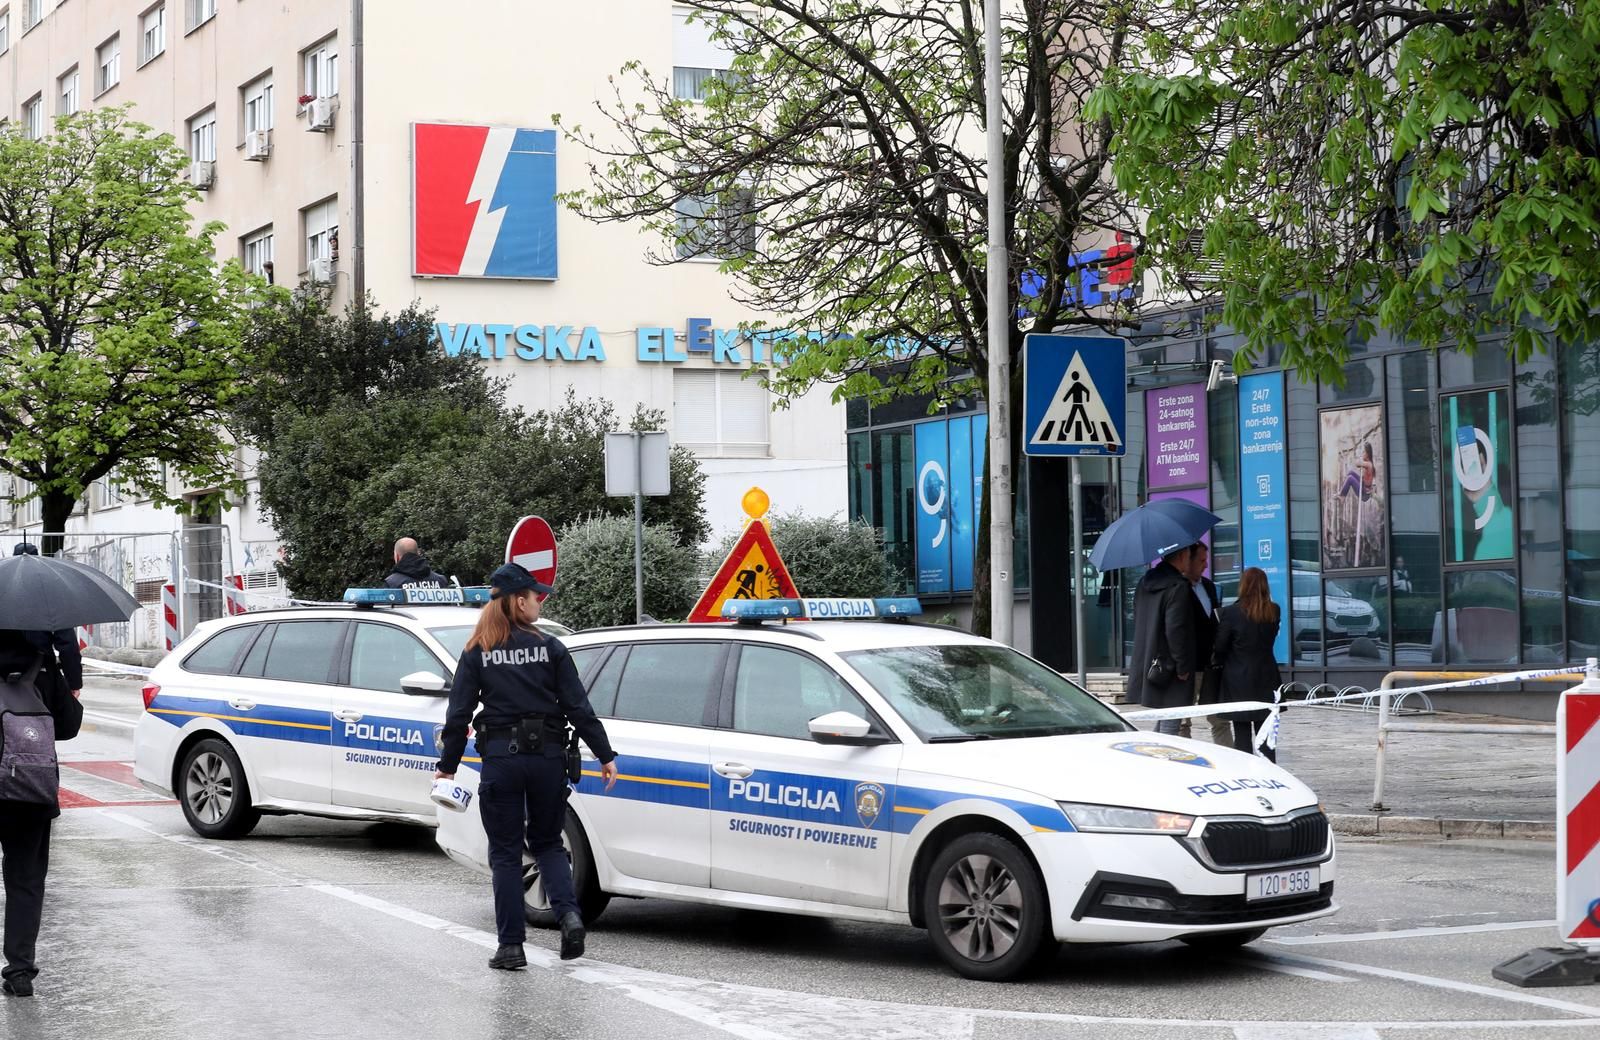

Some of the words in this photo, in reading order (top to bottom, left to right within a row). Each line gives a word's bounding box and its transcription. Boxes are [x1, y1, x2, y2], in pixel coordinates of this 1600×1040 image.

[390, 321, 606, 361] VATSKA
[1158, 396, 1176, 407] Erste
[1177, 395, 1194, 404] zona
[1252, 388, 1270, 401] 24/7
[1159, 408, 1194, 420] 24-satnog
[1251, 403, 1271, 414] Erste
[1157, 420, 1197, 432] bankarenja.
[1245, 415, 1278, 427] non-stop
[1253, 430, 1271, 440] zona
[1160, 441, 1178, 452] Erste
[1179, 439, 1195, 451] 24/7
[1242, 440, 1283, 453] bankarenja
[1156, 455, 1172, 464] ATM
[1173, 452, 1200, 463] banking
[1169, 466, 1187, 476] zone.
[402, 581, 441, 590] POLICIJA
[410, 590, 461, 602] POLICIJA
[809, 602, 872, 617] POLICIJA
[481, 646, 549, 667] POLICIJA
[344, 723, 424, 745] POLICIJA
[345, 752, 392, 767] SIGURNOST
[393, 758, 397, 766] I
[398, 759, 437, 772] POVJERE
[857, 785, 883, 795] POLICIJA
[1187, 779, 1290, 797] POLICIJA
[729, 780, 841, 812] POLICIJA
[729, 819, 794, 839] SIGURNOST
[796, 829, 801, 839] I
[804, 829, 878, 849] POVJERENJE
[1259, 875, 1280, 896] 120
[1289, 871, 1310, 891] 958
